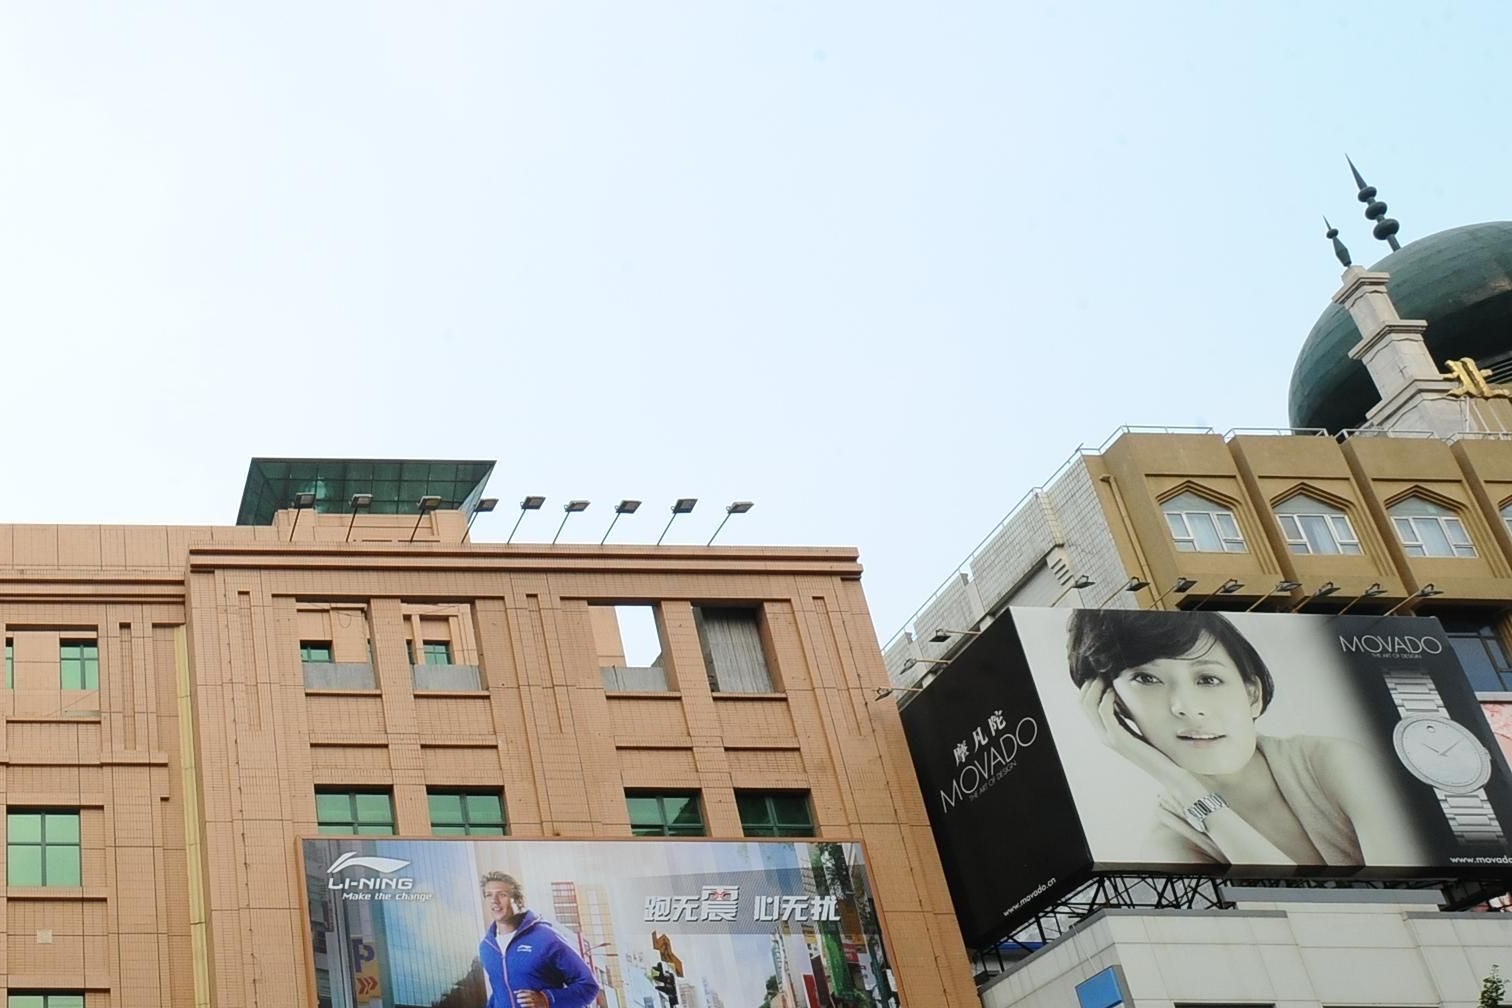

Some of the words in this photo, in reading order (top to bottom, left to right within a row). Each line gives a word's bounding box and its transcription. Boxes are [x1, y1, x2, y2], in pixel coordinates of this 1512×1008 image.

[1339, 635, 1442, 654] MOVADO
[953, 710, 1006, 766] 摩凡陀
[940, 717, 1037, 813] MOVADO
[328, 878, 413, 890] LI-NING
[342, 892, 372, 900] Make
[375, 892, 391, 900] the
[396, 892, 432, 902] change
[1003, 877, 1056, 916] www.movado.cn
